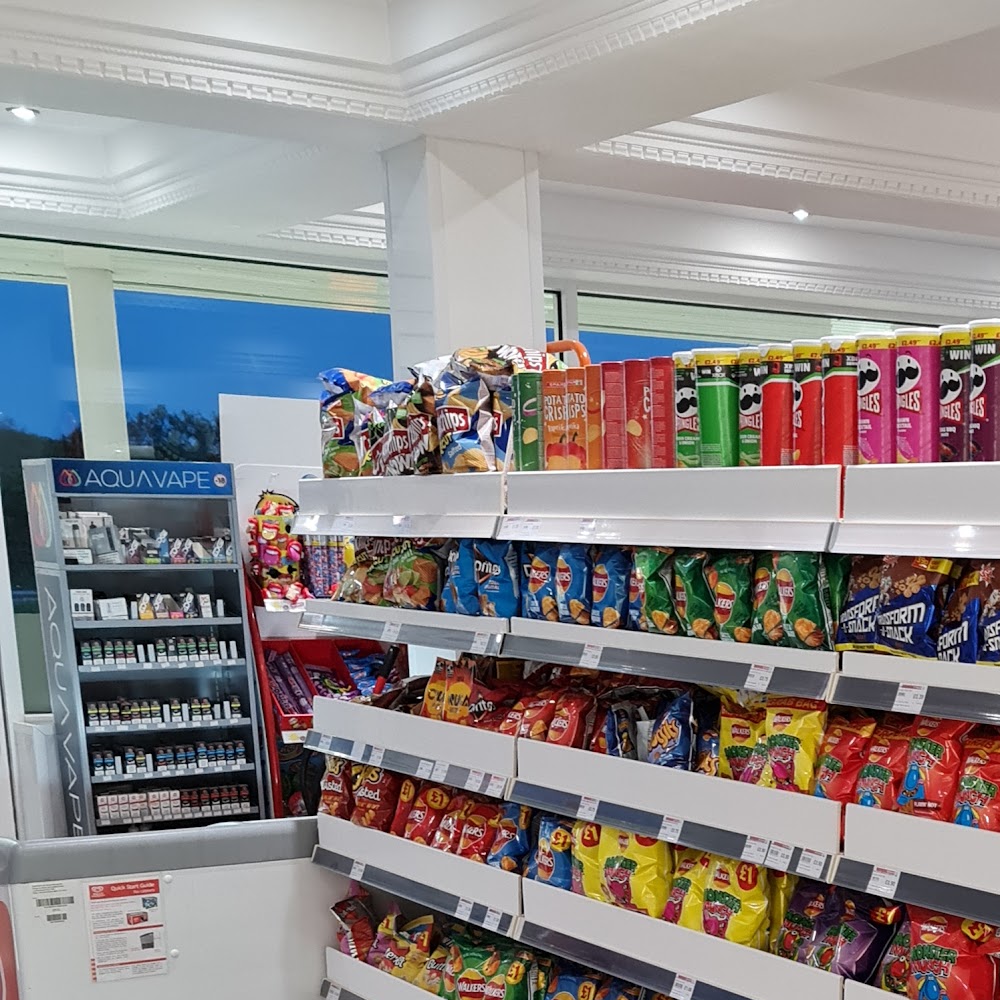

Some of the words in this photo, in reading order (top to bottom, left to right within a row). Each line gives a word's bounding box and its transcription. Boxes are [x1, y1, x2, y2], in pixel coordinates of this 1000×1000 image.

[949, 349, 971, 361] WIN
[975, 343, 996, 355] WIN
[794, 363, 811, 373] WIN
[795, 700, 818, 710] BAG
[430, 791, 446, 804] £1
[551, 831, 568, 847] £1
[739, 864, 755, 884] £1
[457, 980, 486, 994] WALKERS
[580, 984, 591, 1000] £1
